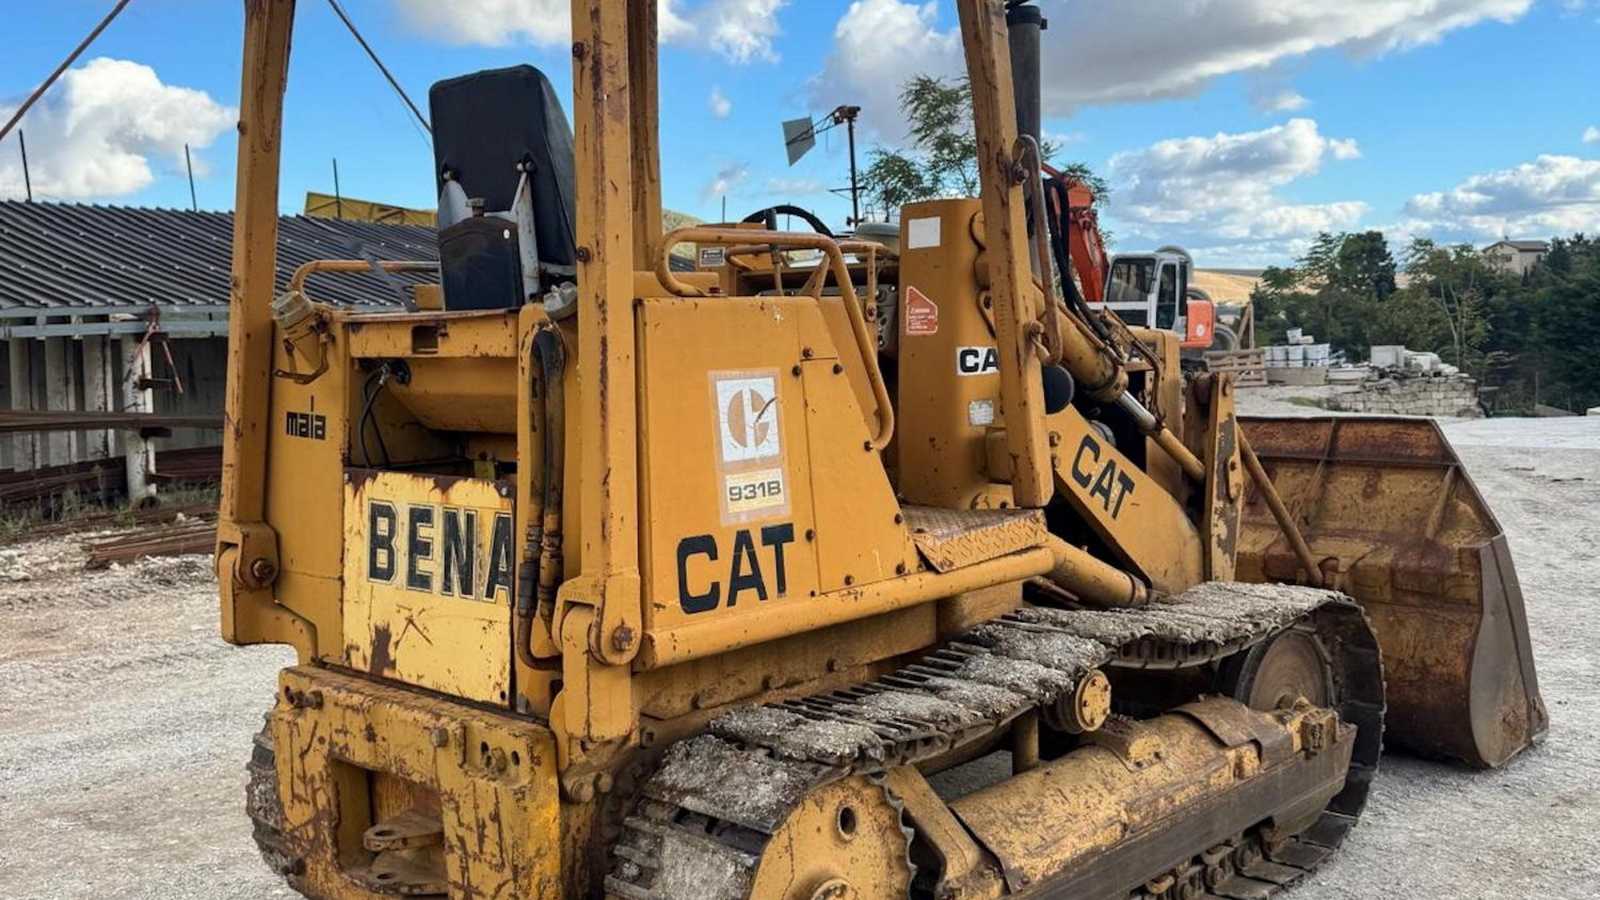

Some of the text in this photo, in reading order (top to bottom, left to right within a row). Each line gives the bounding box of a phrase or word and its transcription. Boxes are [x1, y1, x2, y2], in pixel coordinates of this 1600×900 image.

[959, 348, 1000, 373] CA
[728, 480, 782, 502] 931B
[1072, 433, 1135, 519] CAT
[367, 499, 512, 604] BENA
[677, 523, 794, 615] CAT
